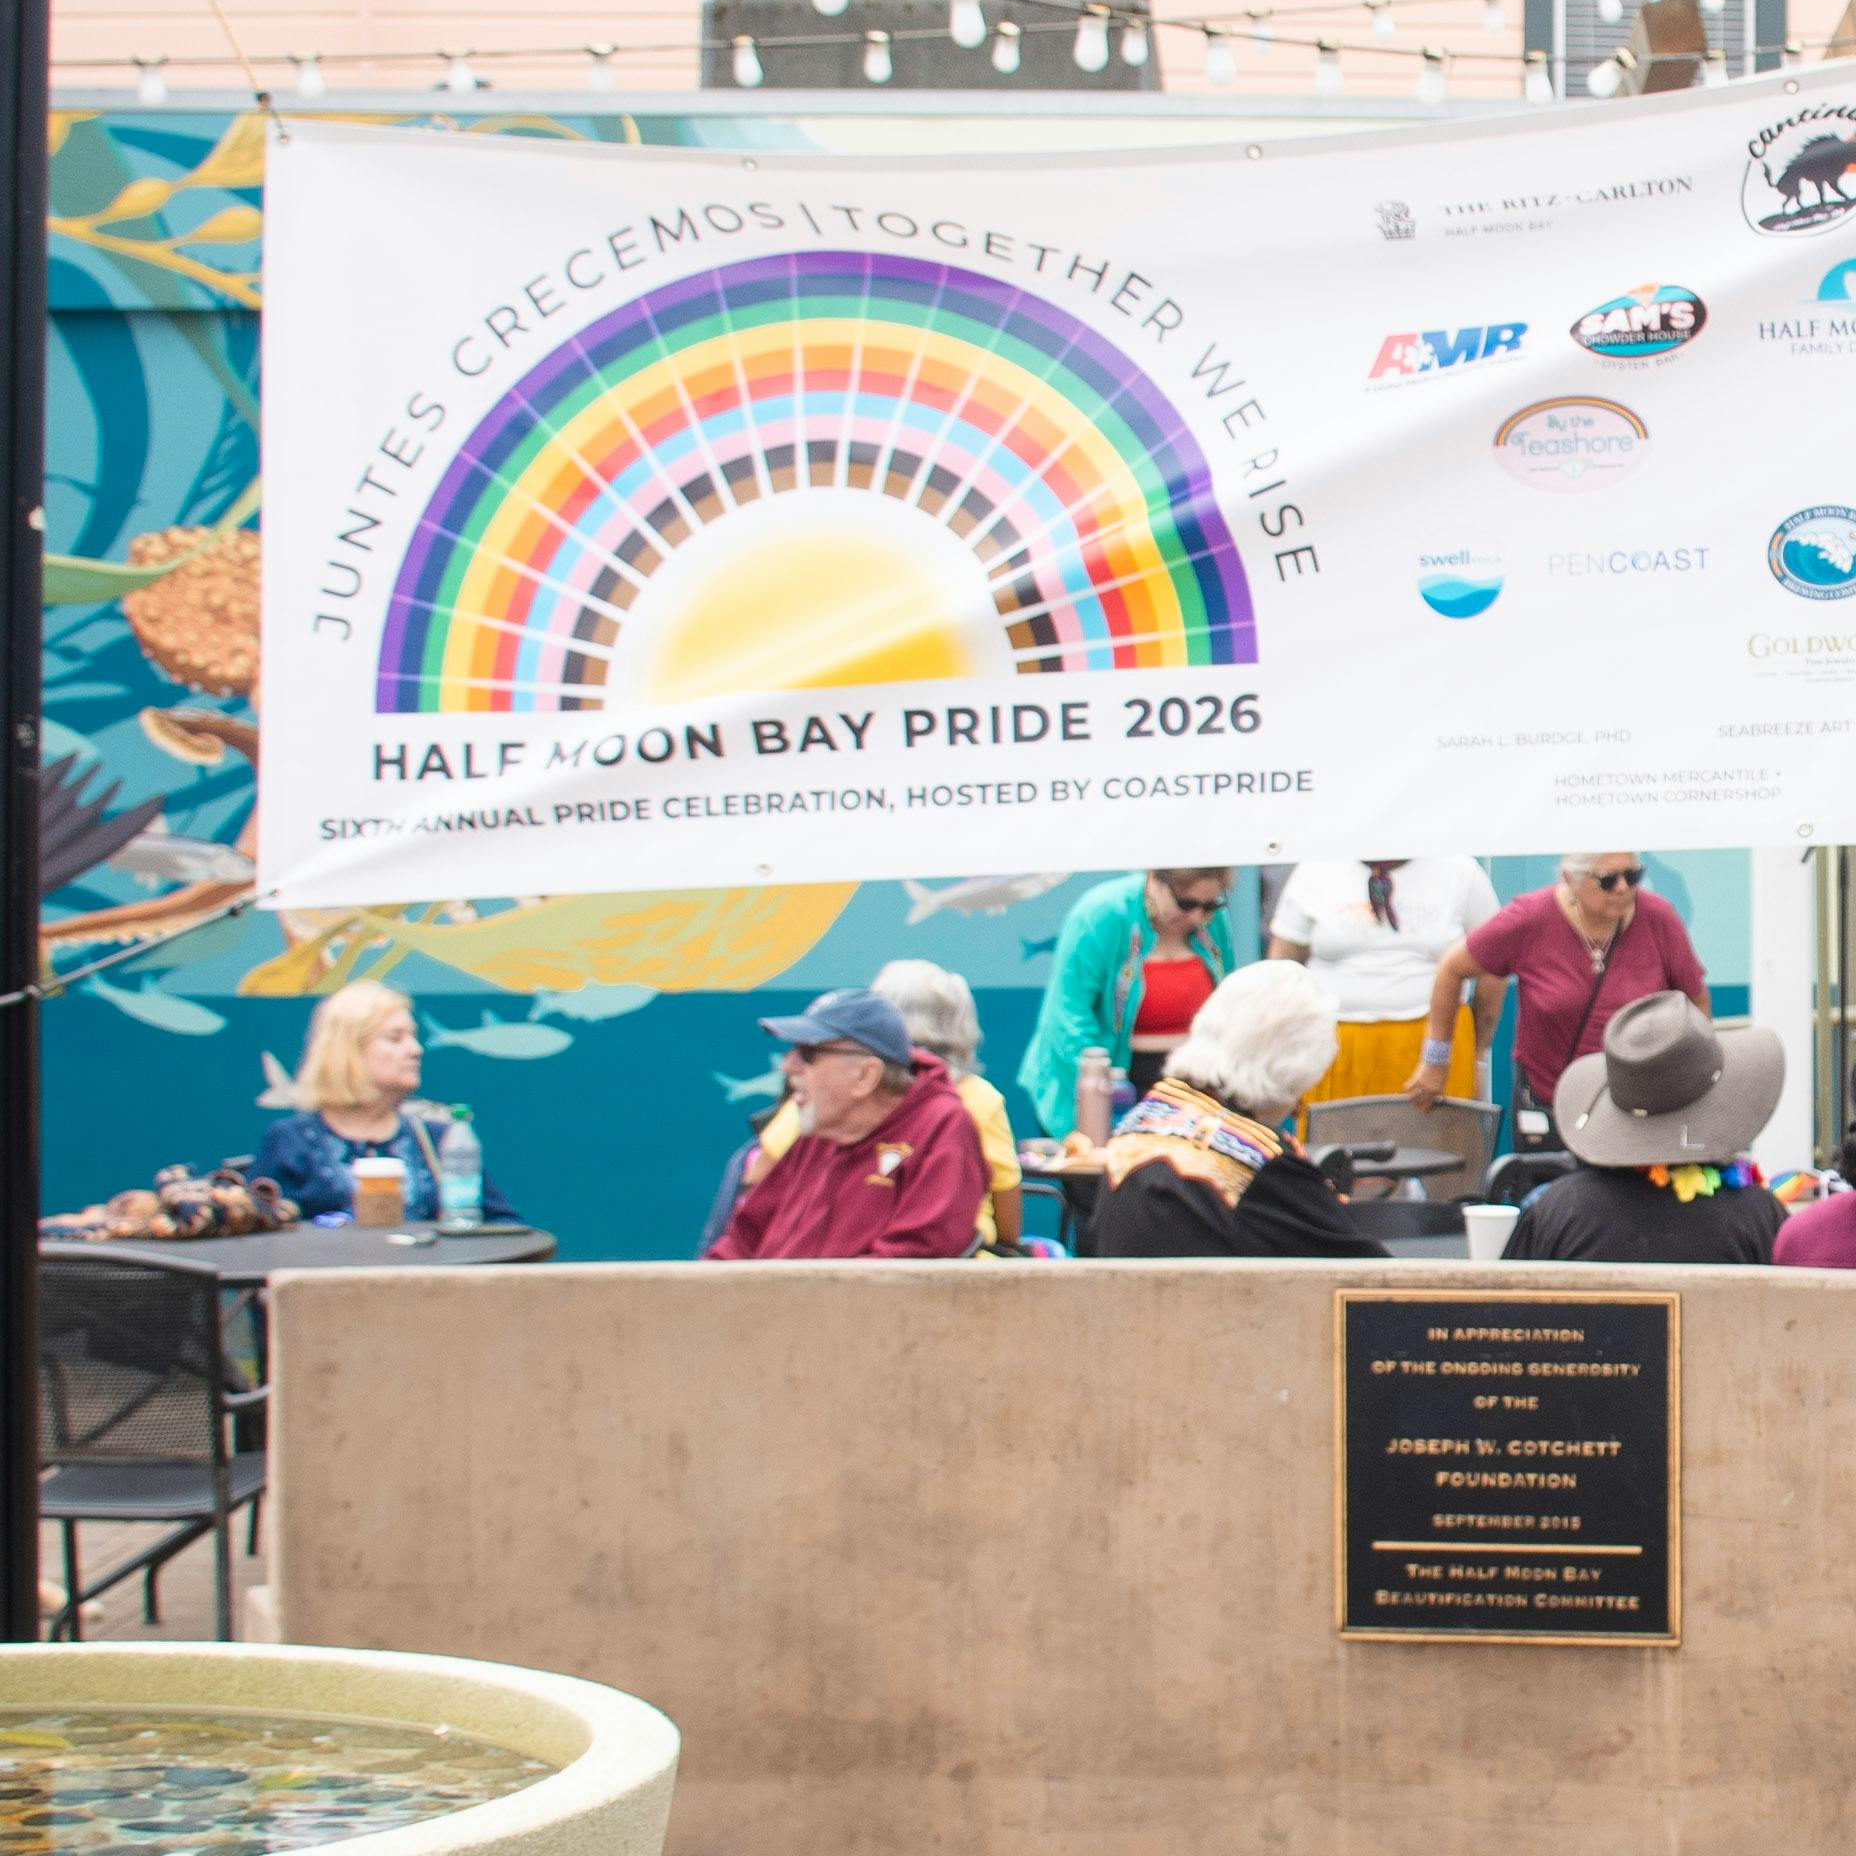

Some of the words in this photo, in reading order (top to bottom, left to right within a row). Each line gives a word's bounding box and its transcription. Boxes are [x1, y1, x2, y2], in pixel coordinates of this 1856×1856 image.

[1442, 200, 1491, 217] THE
[1578, 301, 1696, 336] SAM'S
[1758, 318, 1821, 340] HALF
[1583, 331, 1646, 346] CHOWDER
[1647, 329, 1692, 342] HOUSE
[1791, 341, 1845, 356] FAMILY
[1366, 320, 1531, 381] AMR
[313, 390, 449, 642] JUNTES
[449, 200, 786, 377] CRECEMOS
[831, 203, 1187, 343] TOGETHER
[1190, 340, 1268, 440] WE
[1242, 444, 1321, 584] RISE
[1546, 413, 1567, 432] By
[1570, 414, 1595, 429] the
[1510, 430, 1634, 457] Teashore
[1419, 549, 1470, 568] swell
[1547, 546, 1712, 577] PENCOAST
[371, 740, 528, 782] HALF
[544, 720, 728, 771] MOON
[749, 708, 878, 757] BAY
[903, 699, 1093, 748] PRIDE
[1122, 692, 1264, 739] 2026
[1436, 734, 1494, 750] SARAH
[1594, 728, 1633, 744] PHD
[1716, 719, 1816, 740] SEABREEZE
[1820, 718, 1852, 736] ART
[1553, 772, 1659, 789] HOMETOWN
[1662, 767, 1770, 786] MERCANTILE
[411, 804, 545, 835] ANNUAL
[553, 797, 651, 825] PRIDE
[663, 785, 896, 819] CELEBRATION,
[907, 780, 1039, 809] HOSTED
[1050, 777, 1092, 802] BY
[1102, 768, 1315, 800] COASTPRIDE
[1554, 790, 1660, 808] HOMETOWN
[1662, 785, 1783, 806] CORNERSHOP
[1426, 1327, 1449, 1342] IN
[1453, 1327, 1586, 1344] APPRECIATION
[1370, 1360, 1397, 1375] OF
[1400, 1360, 1437, 1376] THE
[1440, 1361, 1524, 1377] ONGOING
[1527, 1362, 1642, 1378] GENEROSITY
[1473, 1395, 1499, 1410] OF
[1502, 1395, 1539, 1410] THE
[1385, 1438, 1470, 1456] JOSEPH
[1475, 1438, 1502, 1456] W.
[1506, 1440, 1622, 1458] COTCHETT
[1435, 1471, 1578, 1489] FOUNDATION
[1432, 1513, 1536, 1530] SEPTEMBER
